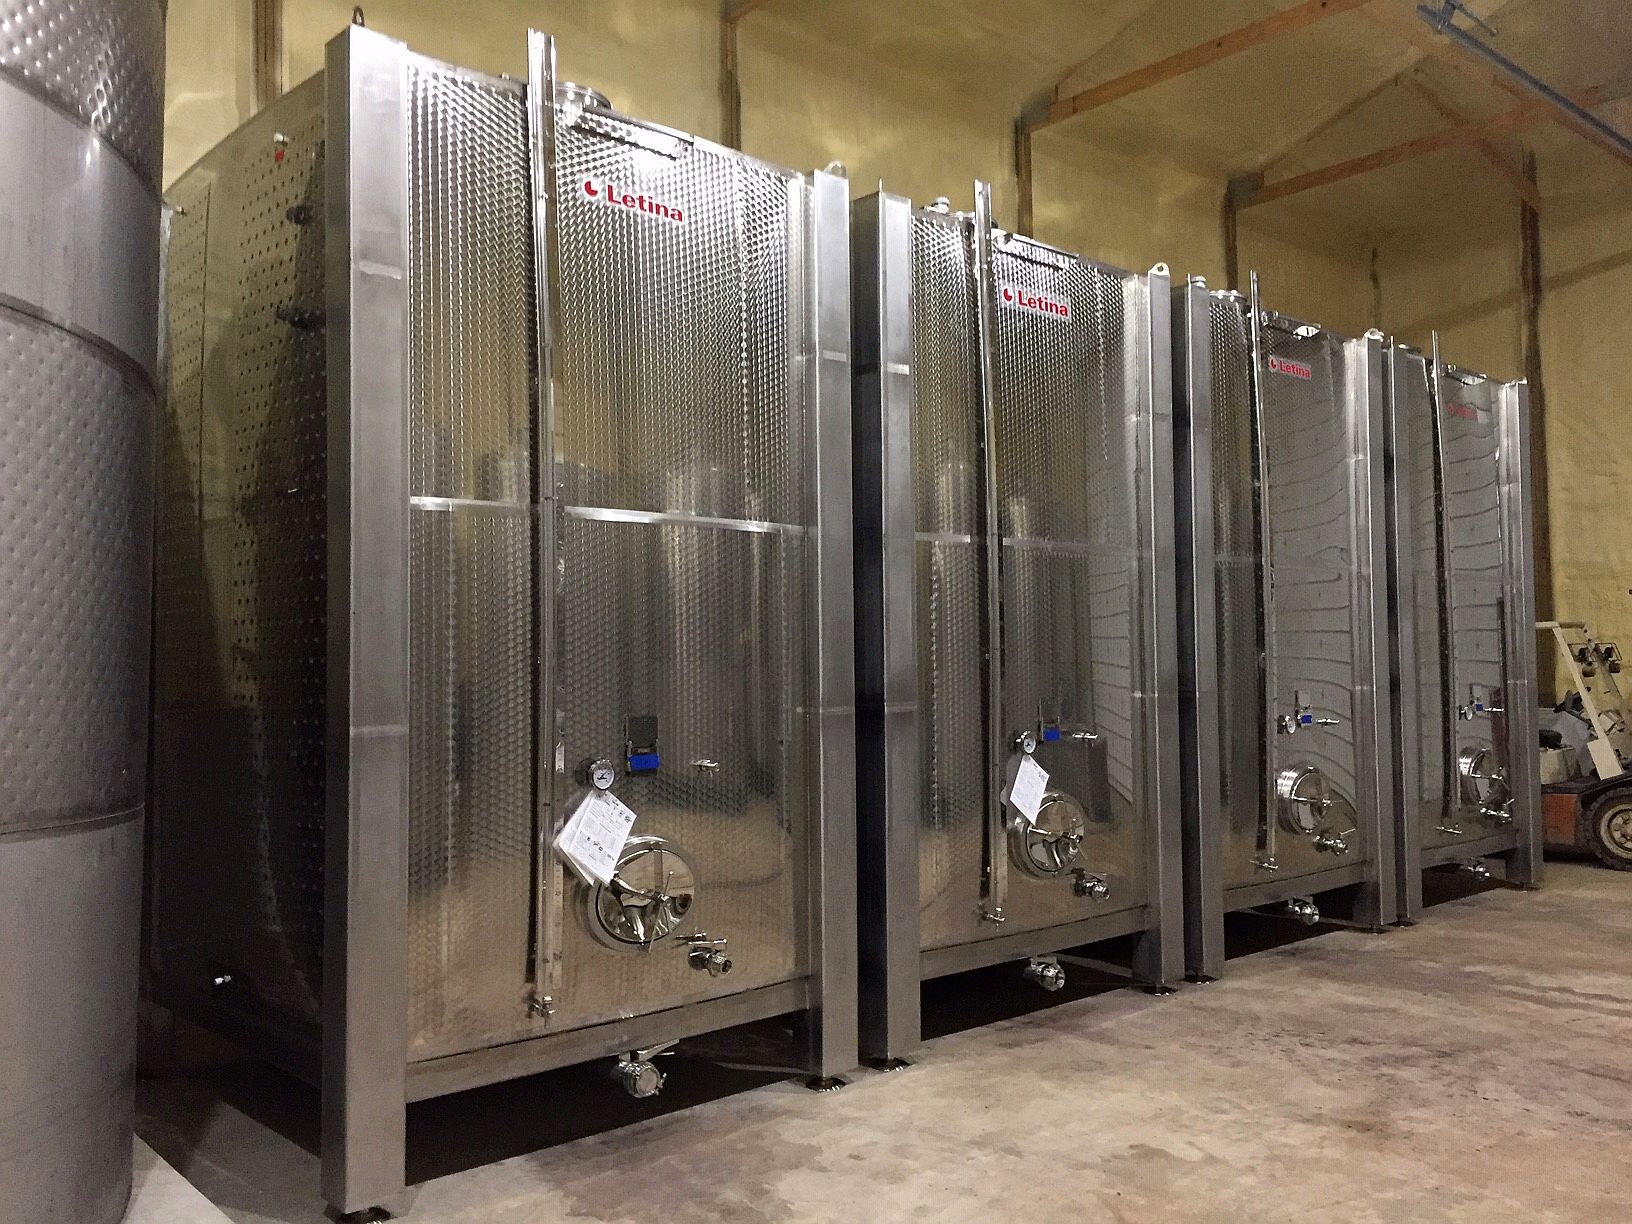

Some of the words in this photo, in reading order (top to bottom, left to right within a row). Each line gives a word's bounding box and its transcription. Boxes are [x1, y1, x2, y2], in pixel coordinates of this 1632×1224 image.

[607, 184, 683, 222] Letina
[1018, 290, 1069, 317] Letina
[1279, 359, 1312, 378] Letina
